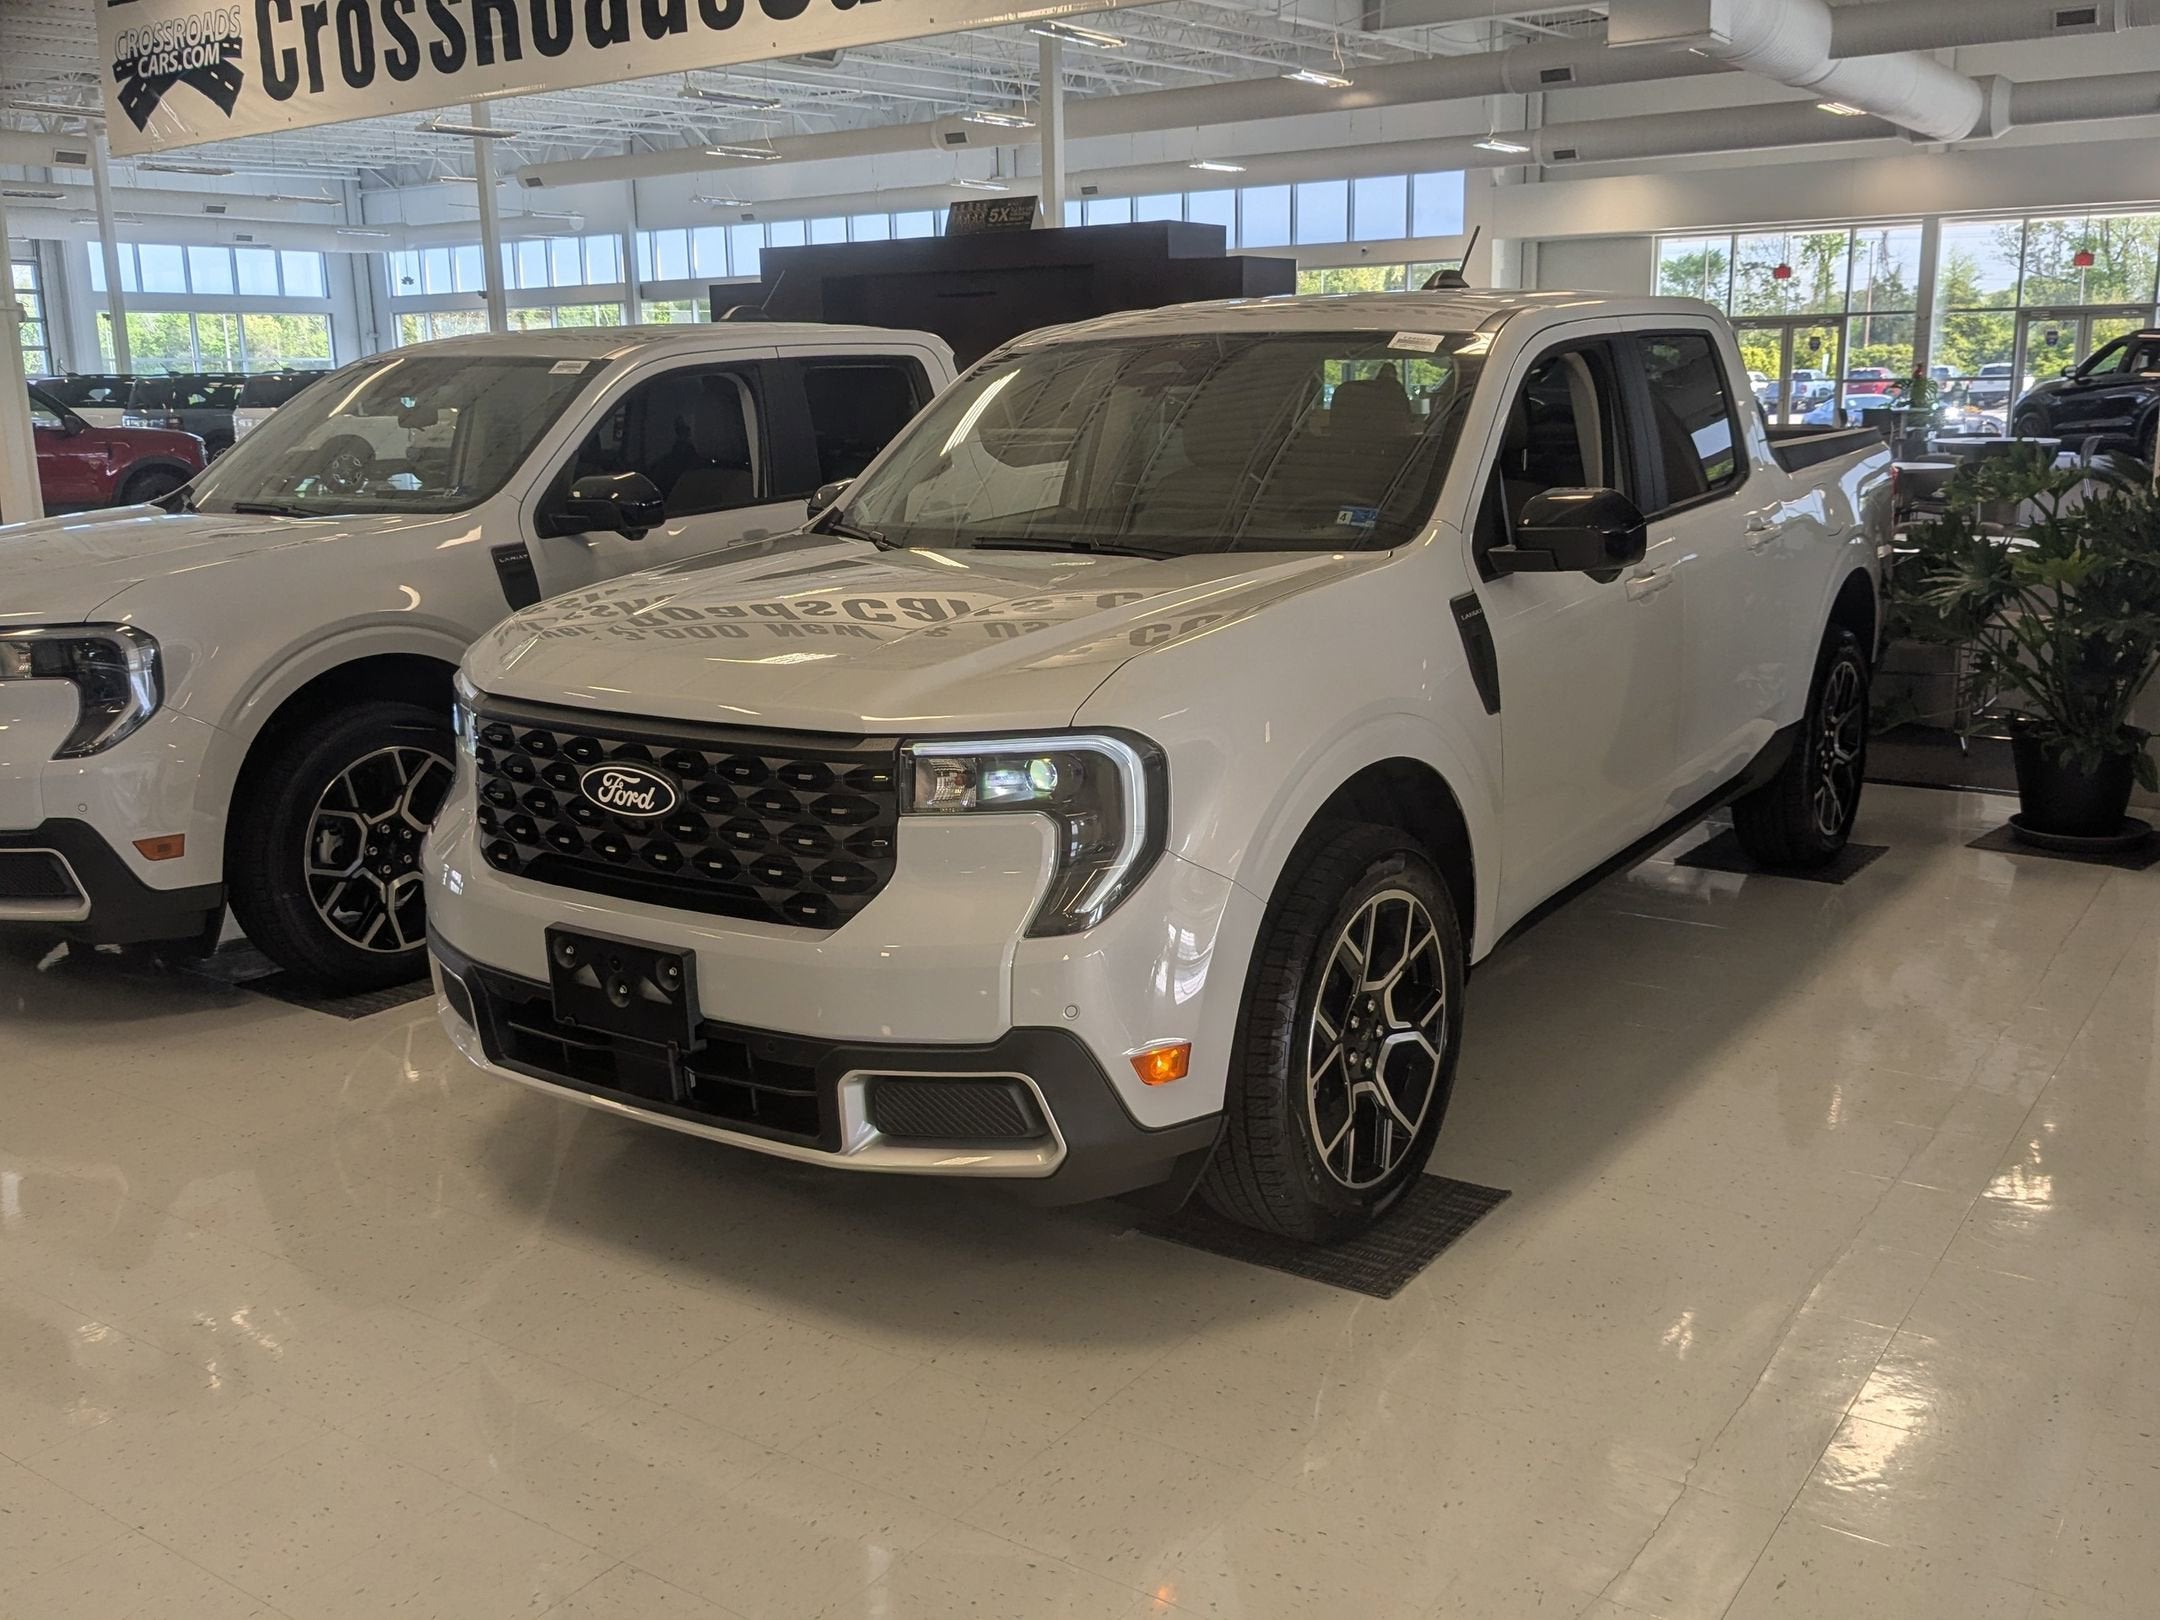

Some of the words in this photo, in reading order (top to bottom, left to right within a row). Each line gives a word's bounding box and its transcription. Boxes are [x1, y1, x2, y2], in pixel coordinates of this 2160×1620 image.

[115, 5, 241, 60] CROSSROADS
[138, 42, 220, 78] CARS.COM
[598, 772, 656, 810] Ford
